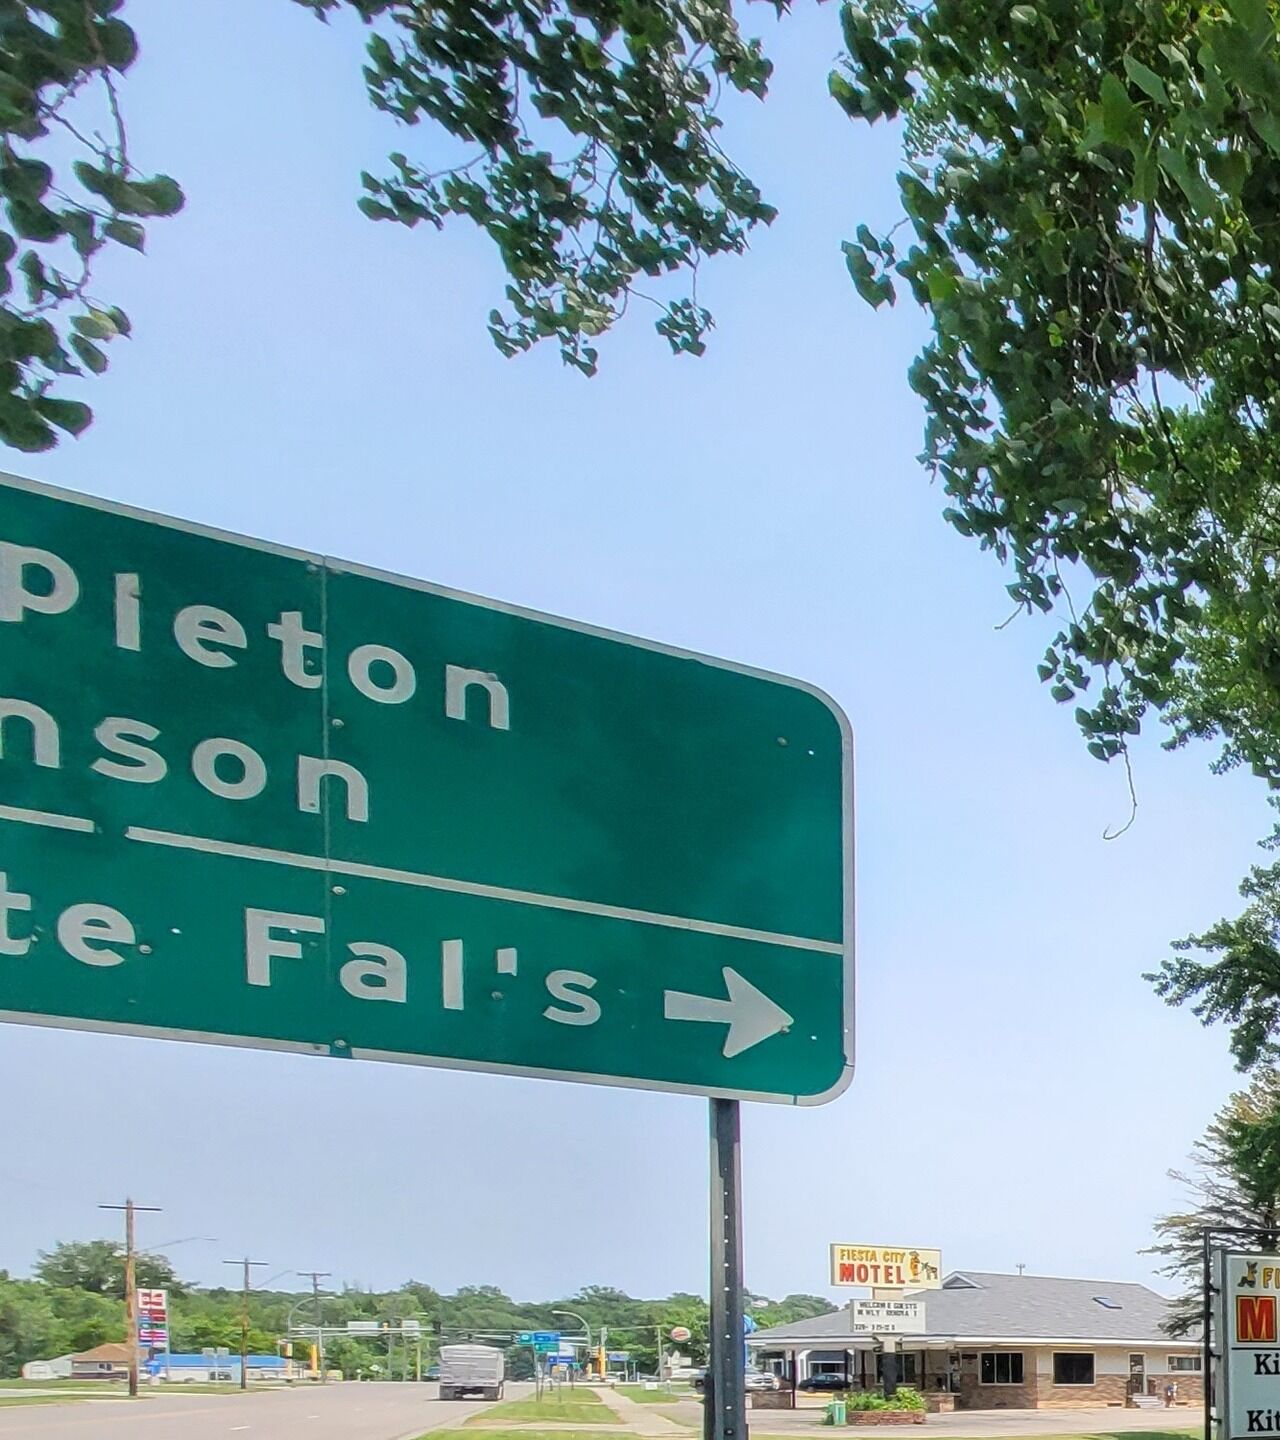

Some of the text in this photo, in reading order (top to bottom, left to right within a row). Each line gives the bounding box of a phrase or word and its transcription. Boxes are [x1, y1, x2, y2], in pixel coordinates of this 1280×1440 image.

[840, 1249, 905, 1263] FIESTA CITY
[839, 1263, 905, 1284] MOTEL
